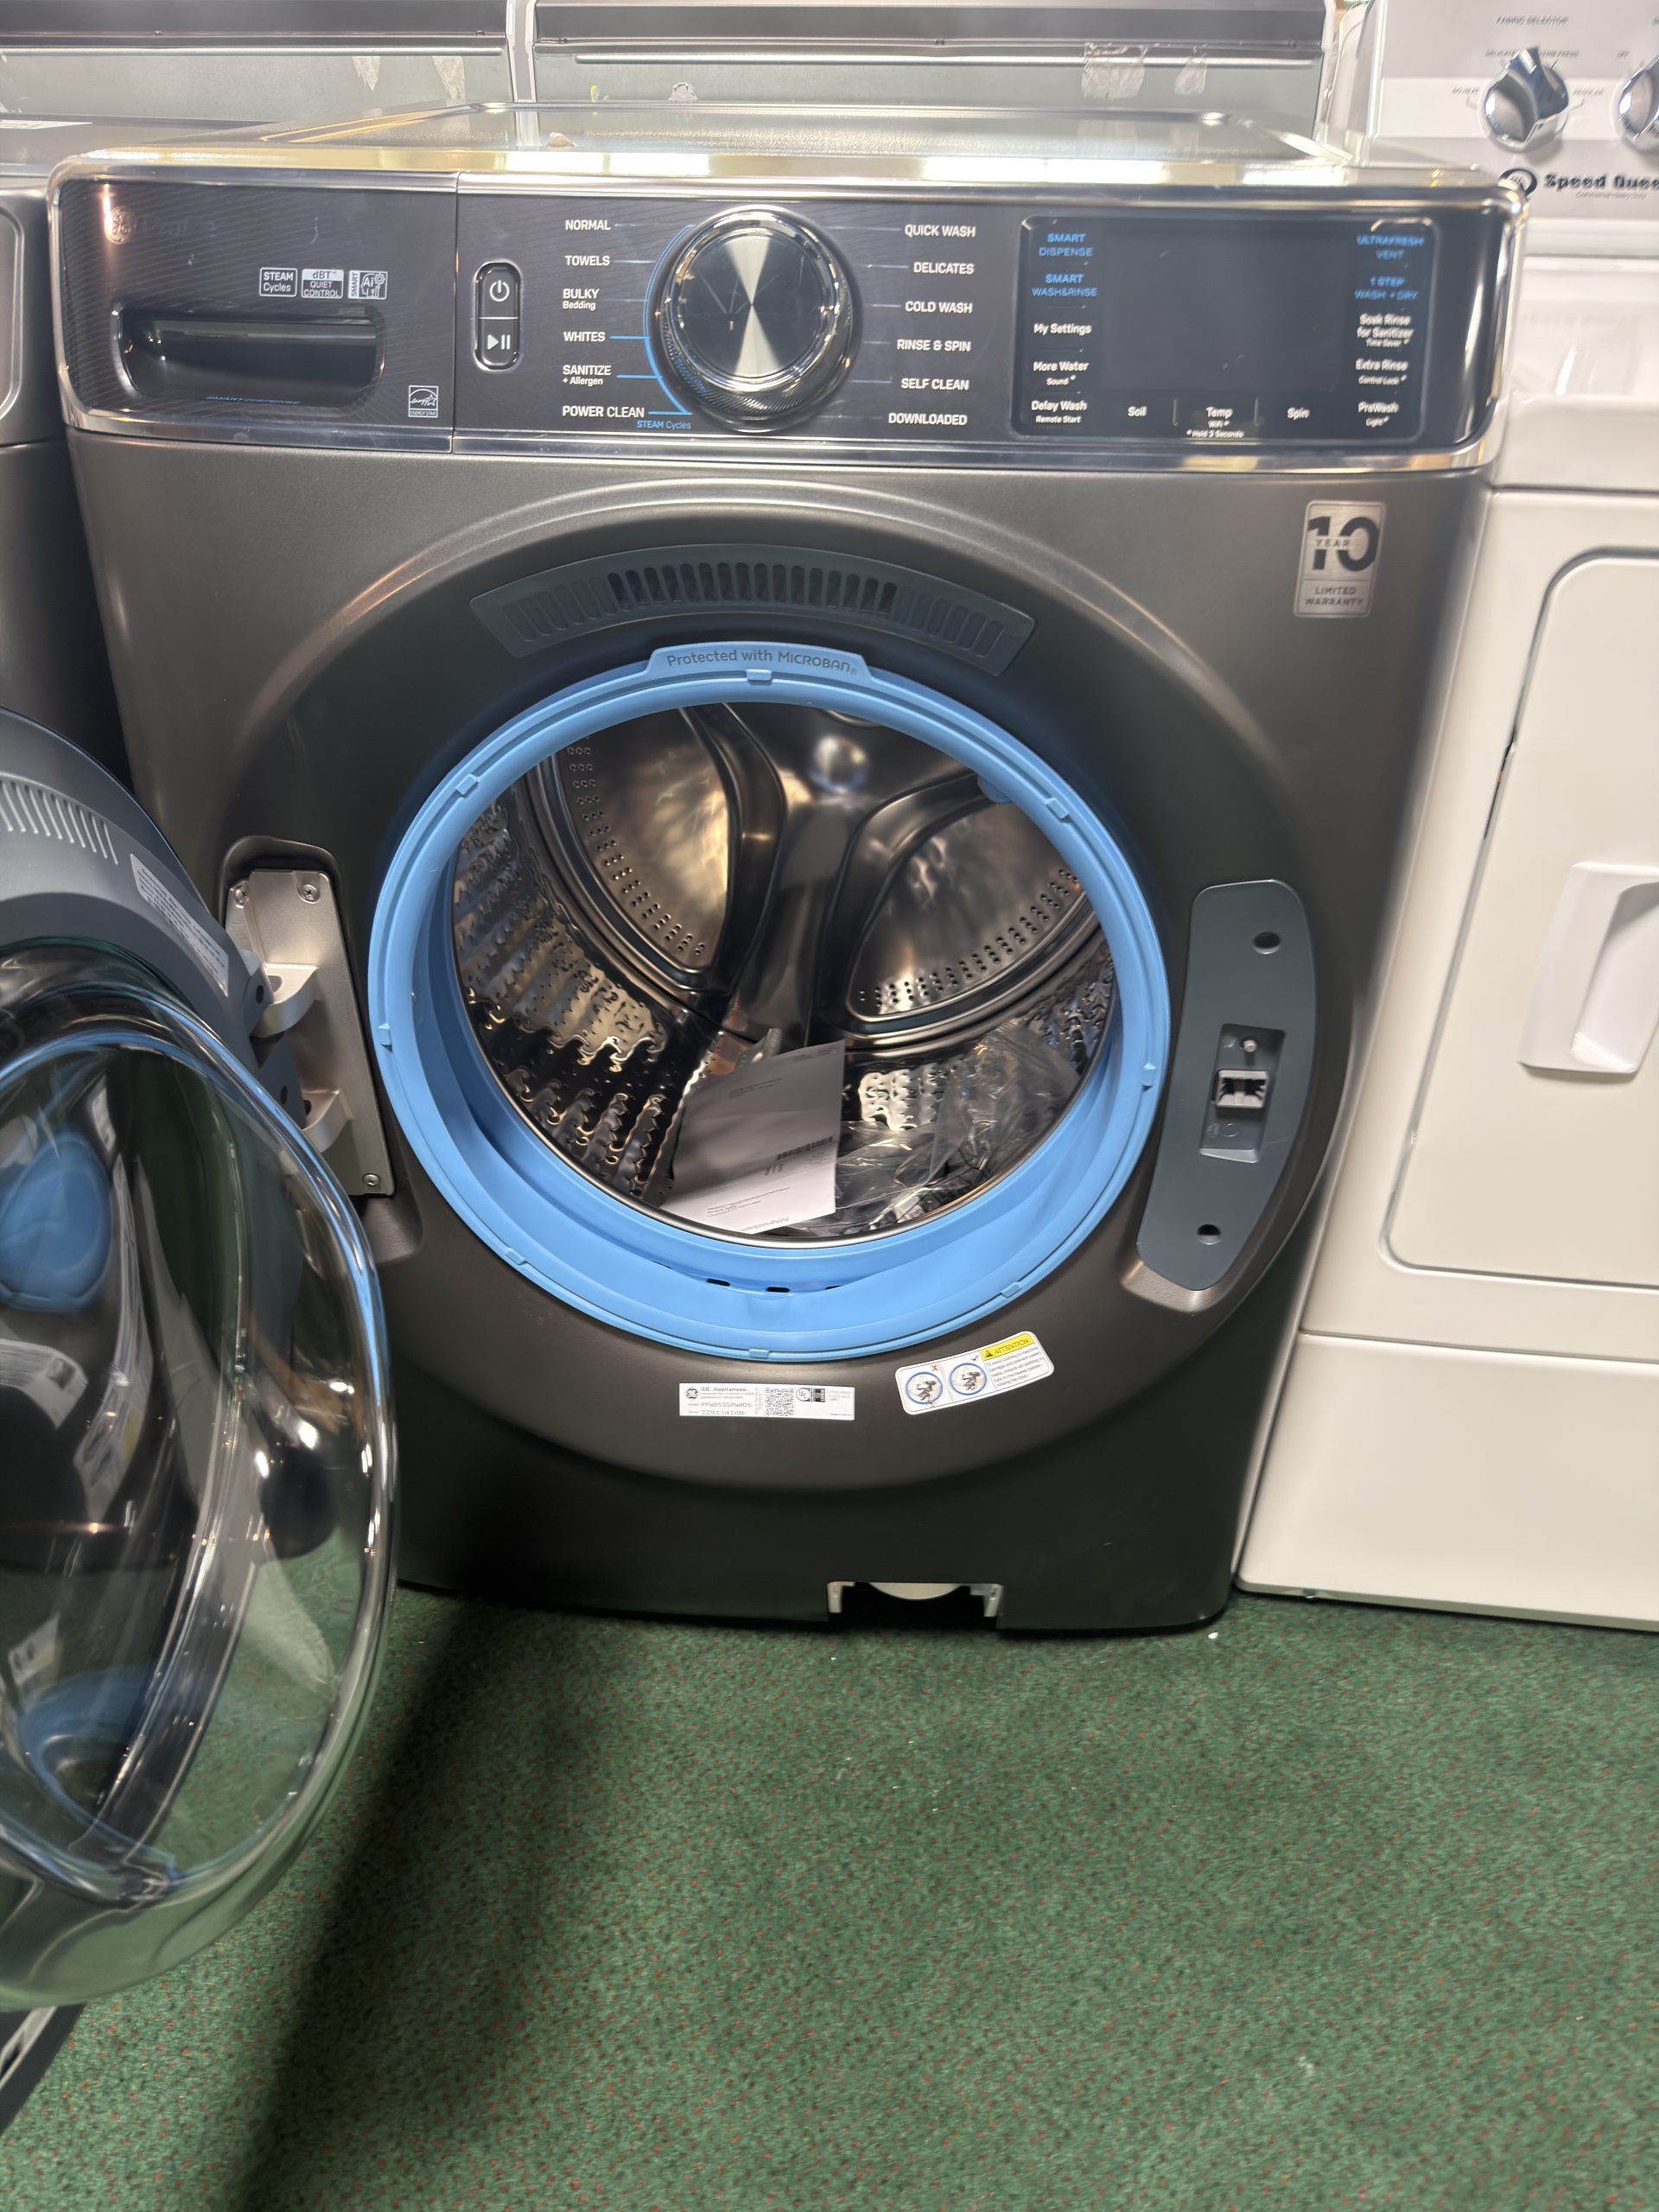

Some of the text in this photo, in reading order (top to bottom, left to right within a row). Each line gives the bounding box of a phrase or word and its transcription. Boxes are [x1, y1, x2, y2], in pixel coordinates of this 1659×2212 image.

[1544, 174, 1606, 191] Speed
[565, 219, 612, 231] NORMAL
[905, 224, 976, 238] QUICK WASH
[1047, 232, 1086, 243] SMART
[1357, 235, 1425, 246] ULTRAFRESH
[1039, 247, 1093, 257] DISPENSE
[1376, 249, 1405, 259] VENT
[564, 256, 610, 266] TOWELS
[913, 262, 975, 275] DELICATES
[264, 271, 294, 281] STEAM
[1046, 273, 1084, 283] SMART
[1377, 276, 1405, 287] STEP
[263, 283, 291, 292] Cycles
[303, 289, 340, 298] CONTROL
[563, 289, 600, 299] BULKY
[1354, 289, 1386, 300] WASH
[563, 301, 596, 311] Bedding
[905, 301, 973, 314] COLD WASH
[1359, 313, 1411, 326] Soak Rinse
[1033, 322, 1092, 336] My Settings
[1357, 327, 1414, 338] for Sanitizer
[563, 332, 606, 342] WHITES
[897, 339, 971, 352] RINSE & SPIN
[563, 365, 612, 376] SANITIZE
[1033, 361, 1090, 372] More Water
[1356, 359, 1408, 371] Extra Rinse
[569, 377, 603, 386] Allergen
[901, 378, 969, 390] SELF CLEAN
[1046, 377, 1069, 385] Sound
[1358, 375, 1400, 385] Control Lock
[1031, 400, 1088, 412] Delay Wash
[1128, 406, 1147, 417] Soil
[563, 406, 645, 418] POWER CLEAN
[1205, 406, 1233, 419] Temp
[1287, 407, 1310, 420] Spin
[888, 412, 968, 426] DOWNLOADED
[637, 420, 691, 430] STEAM Cycles
[1192, 429, 1244, 438] Hold 3 Seconds
[1307, 516, 1381, 572] 10
[1315, 537, 1351, 548] YEAR
[1314, 586, 1356, 595] LIMITED
[1305, 596, 1363, 607] WARRANTY
[666, 650, 737, 667] Protected
[741, 650, 772, 662] with
[995, 1338, 1029, 1354] ATTENTION
